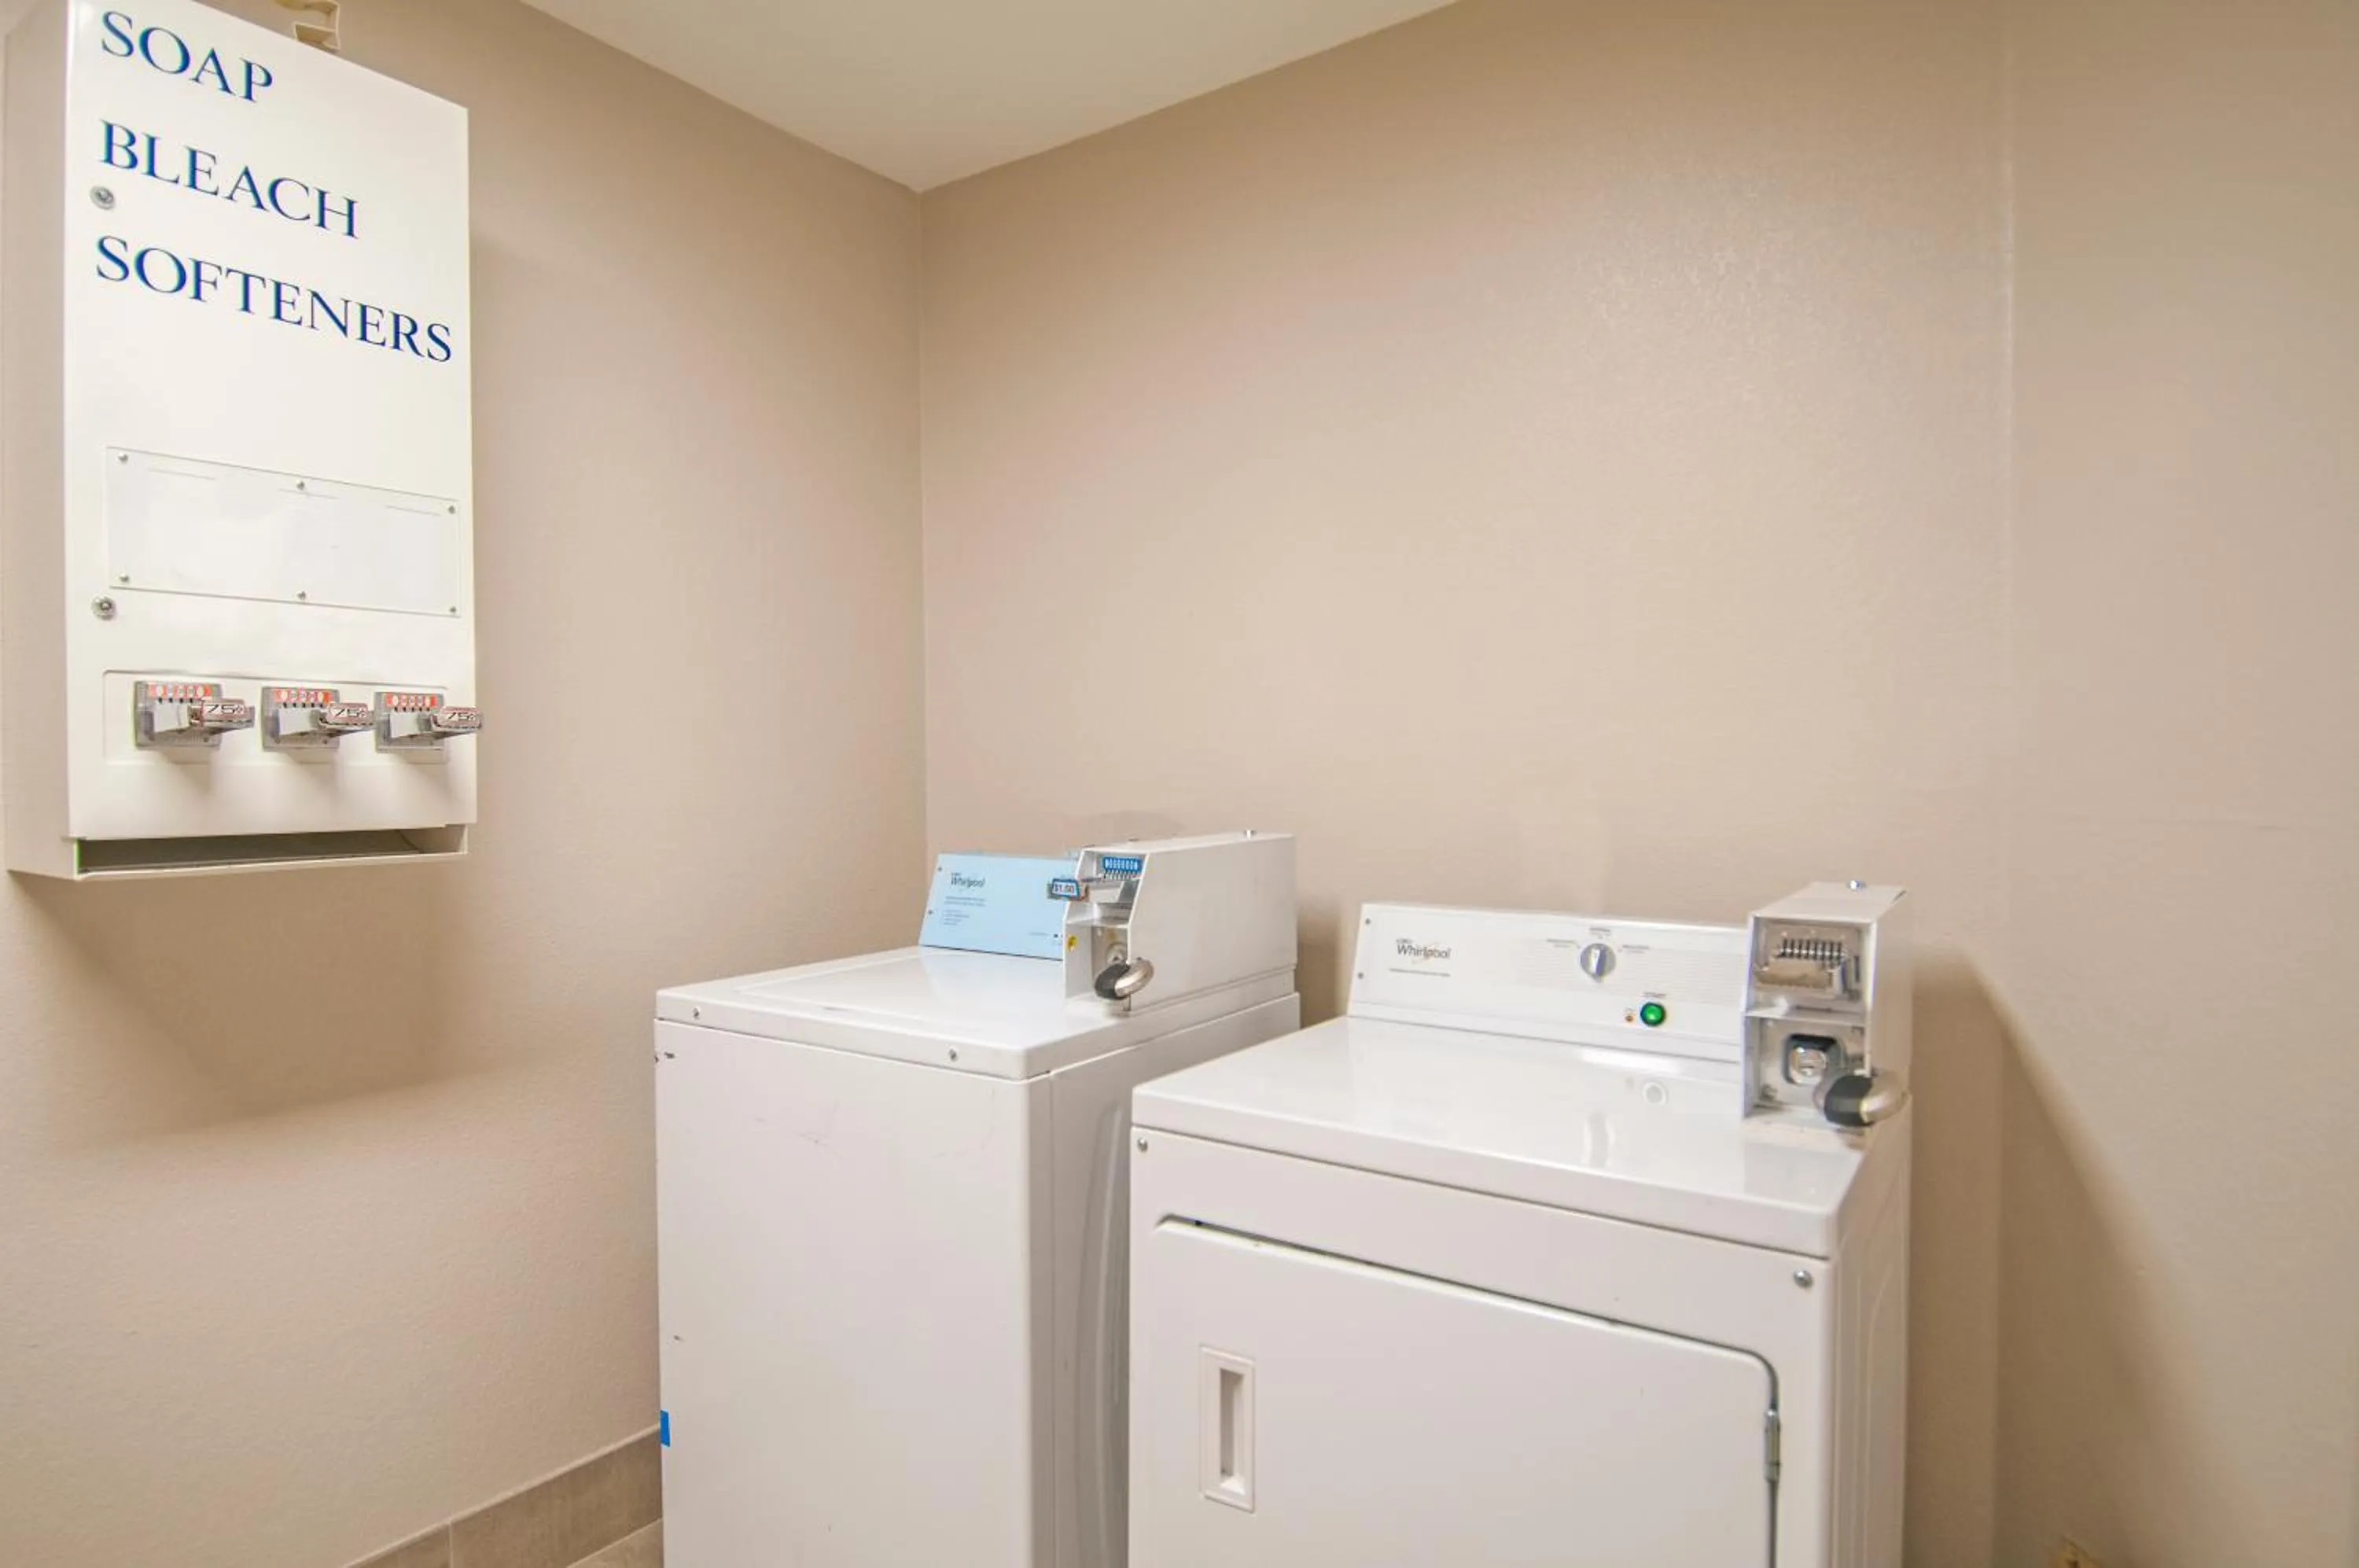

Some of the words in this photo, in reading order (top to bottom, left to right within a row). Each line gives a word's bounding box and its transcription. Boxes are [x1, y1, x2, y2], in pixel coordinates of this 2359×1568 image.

[101, 11, 273, 103] SOAP
[100, 120, 359, 239] BLEACH
[96, 235, 452, 363] SOFTENERS
[1397, 944, 1451, 960] Whirlpool
